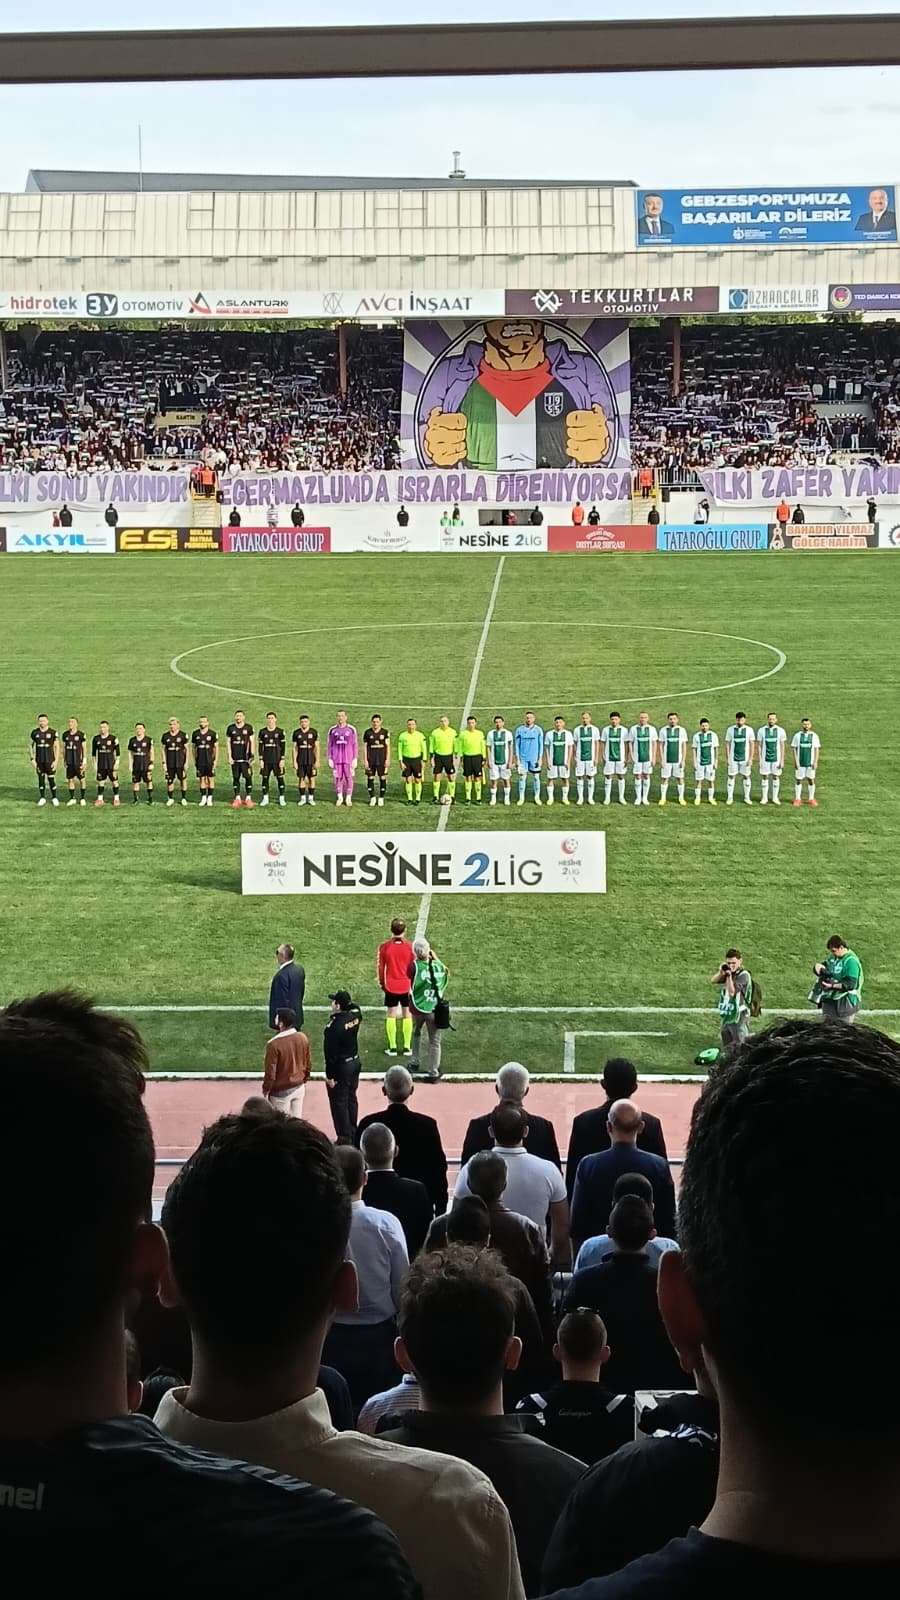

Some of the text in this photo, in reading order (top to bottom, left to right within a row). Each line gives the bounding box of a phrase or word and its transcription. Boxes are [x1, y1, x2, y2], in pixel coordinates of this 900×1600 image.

[681, 192, 851, 207] GEBZESPOR'UMUZA
[681, 208, 851, 226] BAŞARILAR DİLERİZ
[11, 296, 78, 310] hidrotek
[355, 291, 473, 315] AVCI İNŞAAT
[569, 287, 694, 304] TEKKURTLAR
[123, 301, 183, 312] OTOMOTİV
[37, 474, 88, 501] SONU
[97, 474, 188, 502] YAKINDIR
[762, 468, 832, 498] ZAFER
[786, 524, 874, 535] BAHADIR YILMAZ
[229, 530, 324, 552] TATAROĞLU GRUP
[664, 528, 761, 550] TATAROĞLU GRUP
